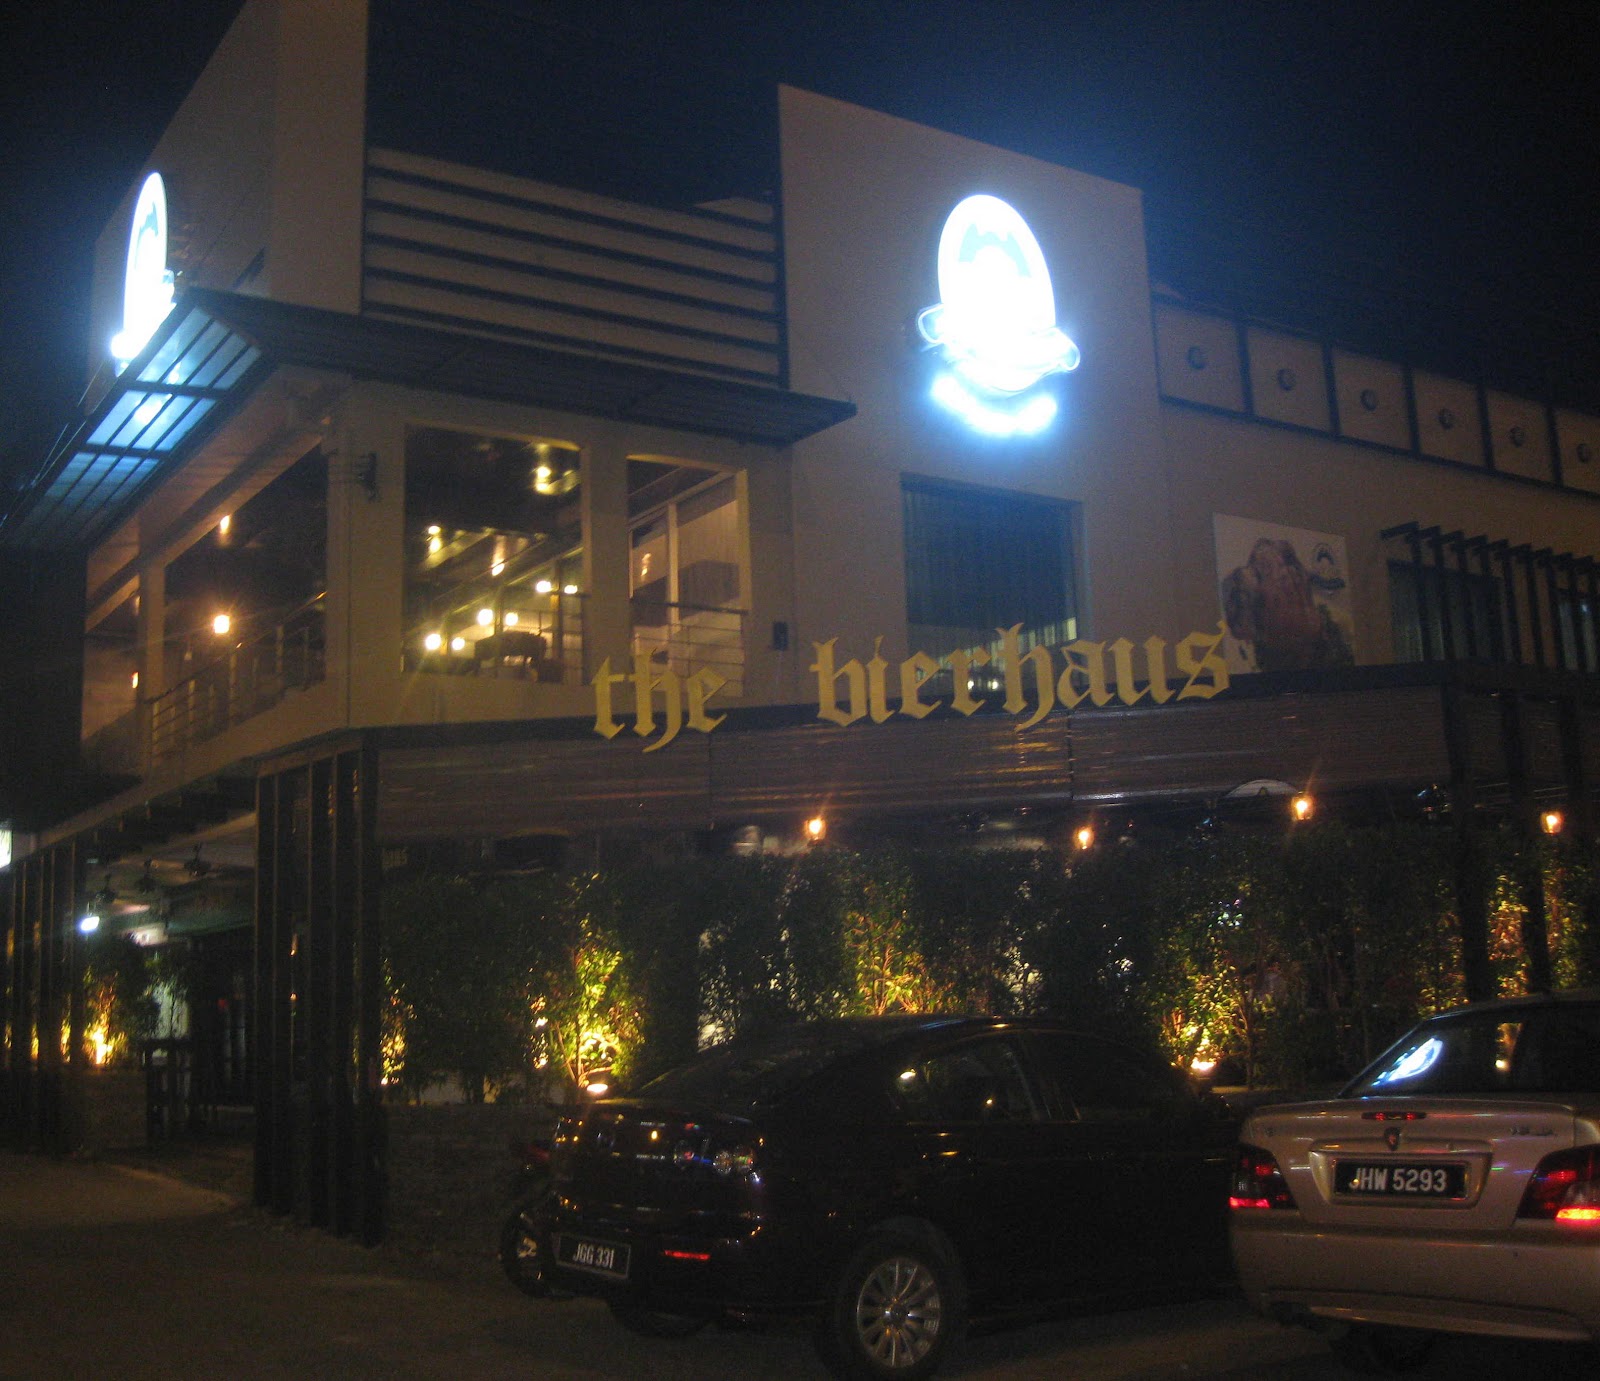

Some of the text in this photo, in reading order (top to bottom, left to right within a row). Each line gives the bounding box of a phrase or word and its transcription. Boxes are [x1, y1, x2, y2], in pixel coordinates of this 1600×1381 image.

[593, 621, 1231, 753] the bierhaus
[1349, 1166, 1448, 1192] JHW 5293
